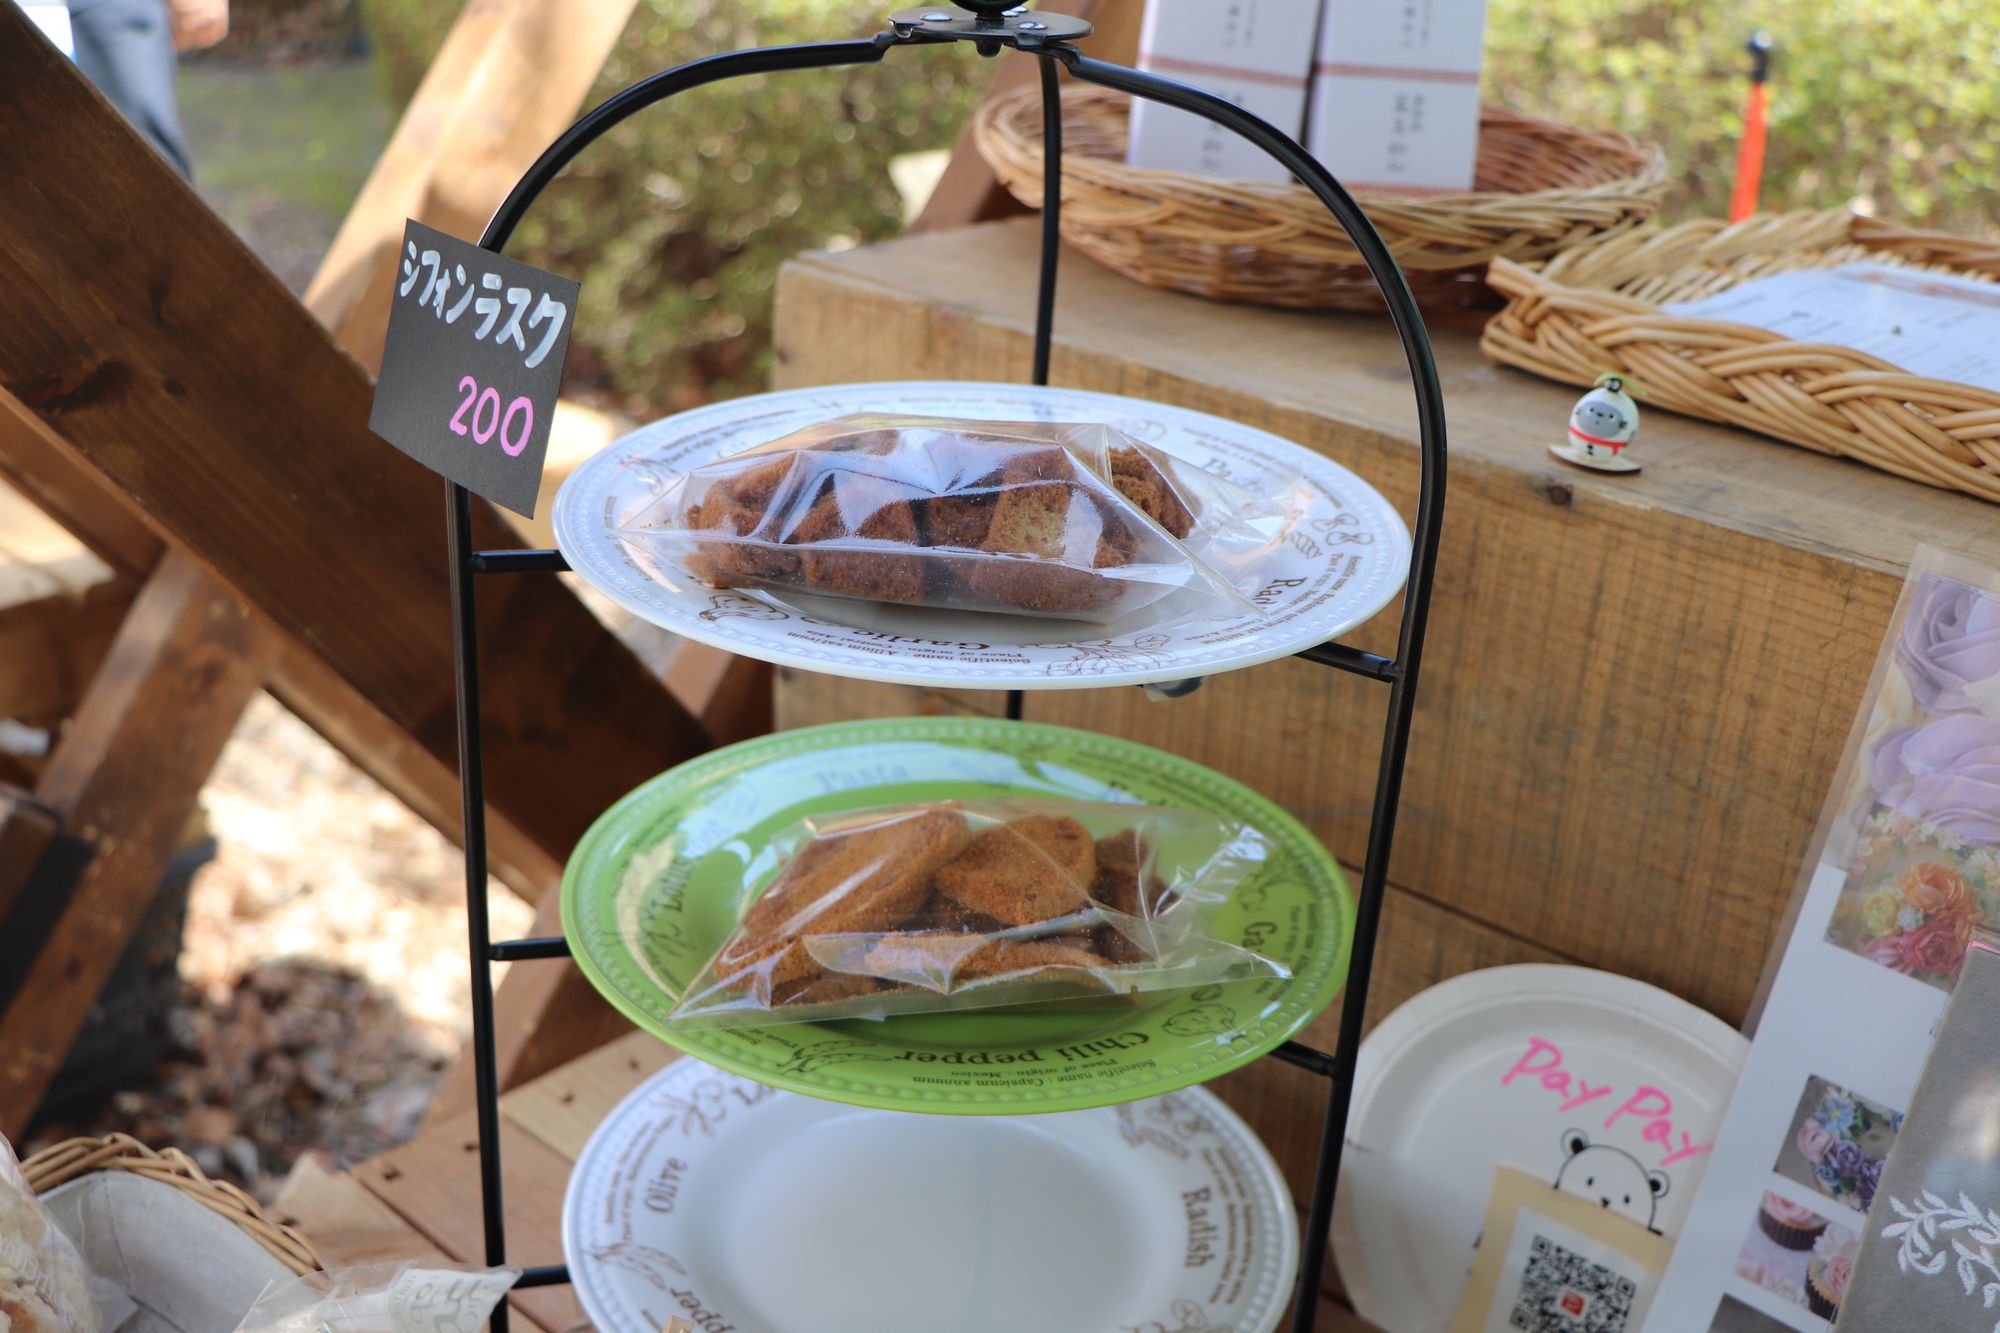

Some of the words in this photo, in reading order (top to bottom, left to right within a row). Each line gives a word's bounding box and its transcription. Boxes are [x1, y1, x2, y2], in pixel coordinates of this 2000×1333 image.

[449, 375, 534, 457] 200
[853, 629, 991, 650] Garlic
[912, 653, 954, 661] name
[959, 656, 1032, 666] Scientific
[1054, 1030, 1151, 1062] Chili
[894, 1049, 1047, 1066] pepper
[1056, 1070, 1093, 1084] name
[1097, 1058, 1157, 1078] Scientific
[975, 1076, 1044, 1088] Capsicum
[645, 1158, 687, 1214] Olive
[1183, 1187, 1219, 1268] Radish
